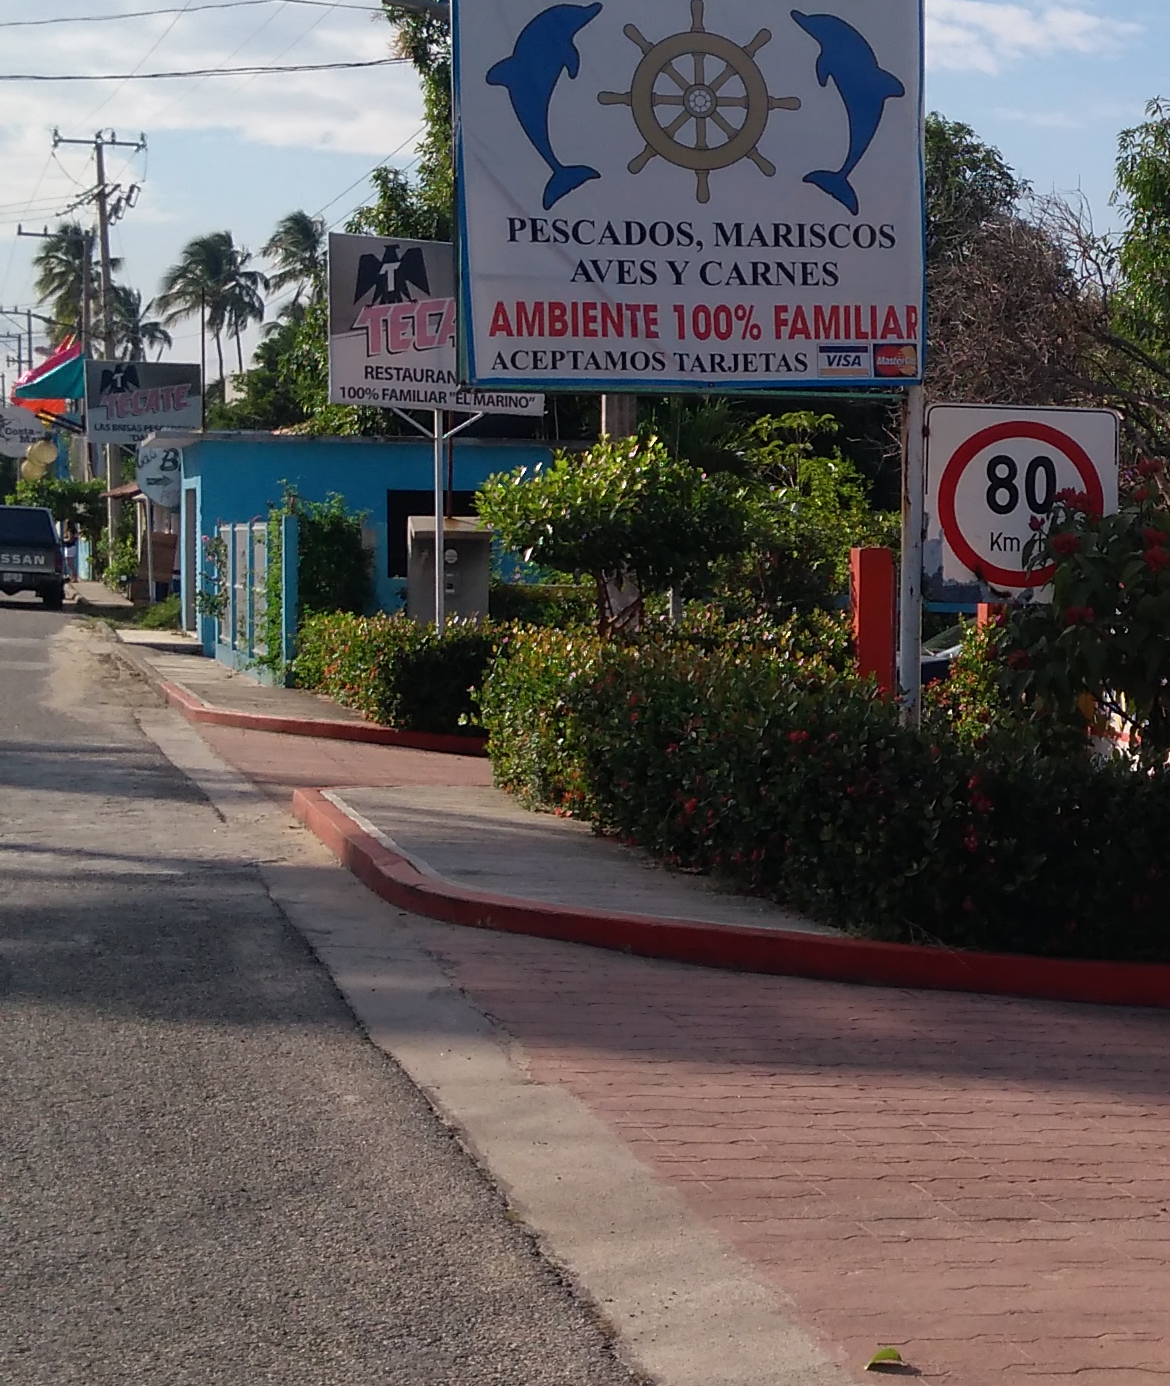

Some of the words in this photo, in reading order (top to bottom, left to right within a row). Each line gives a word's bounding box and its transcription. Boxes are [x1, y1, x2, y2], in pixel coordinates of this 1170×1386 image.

[507, 217, 704, 252] PESCADOS,
[712, 221, 896, 249] MARISCOS
[570, 259, 658, 286] AVES
[665, 260, 690, 286] Y
[699, 261, 839, 287] CARNES
[489, 300, 660, 339] AMBIENTE
[673, 303, 762, 341] 100%
[773, 304, 918, 340] FAMILIAR
[491, 349, 666, 372] ACEPTAMOS
[673, 352, 808, 373] TARJETAS
[826, 354, 862, 367] VISA
[100, 383, 193, 421] TECATE
[340, 386, 379, 401] 100%
[382, 387, 447, 404] FAMILIAR
[473, 394, 536, 409] MARINO"
[986, 454, 1057, 515] 80
